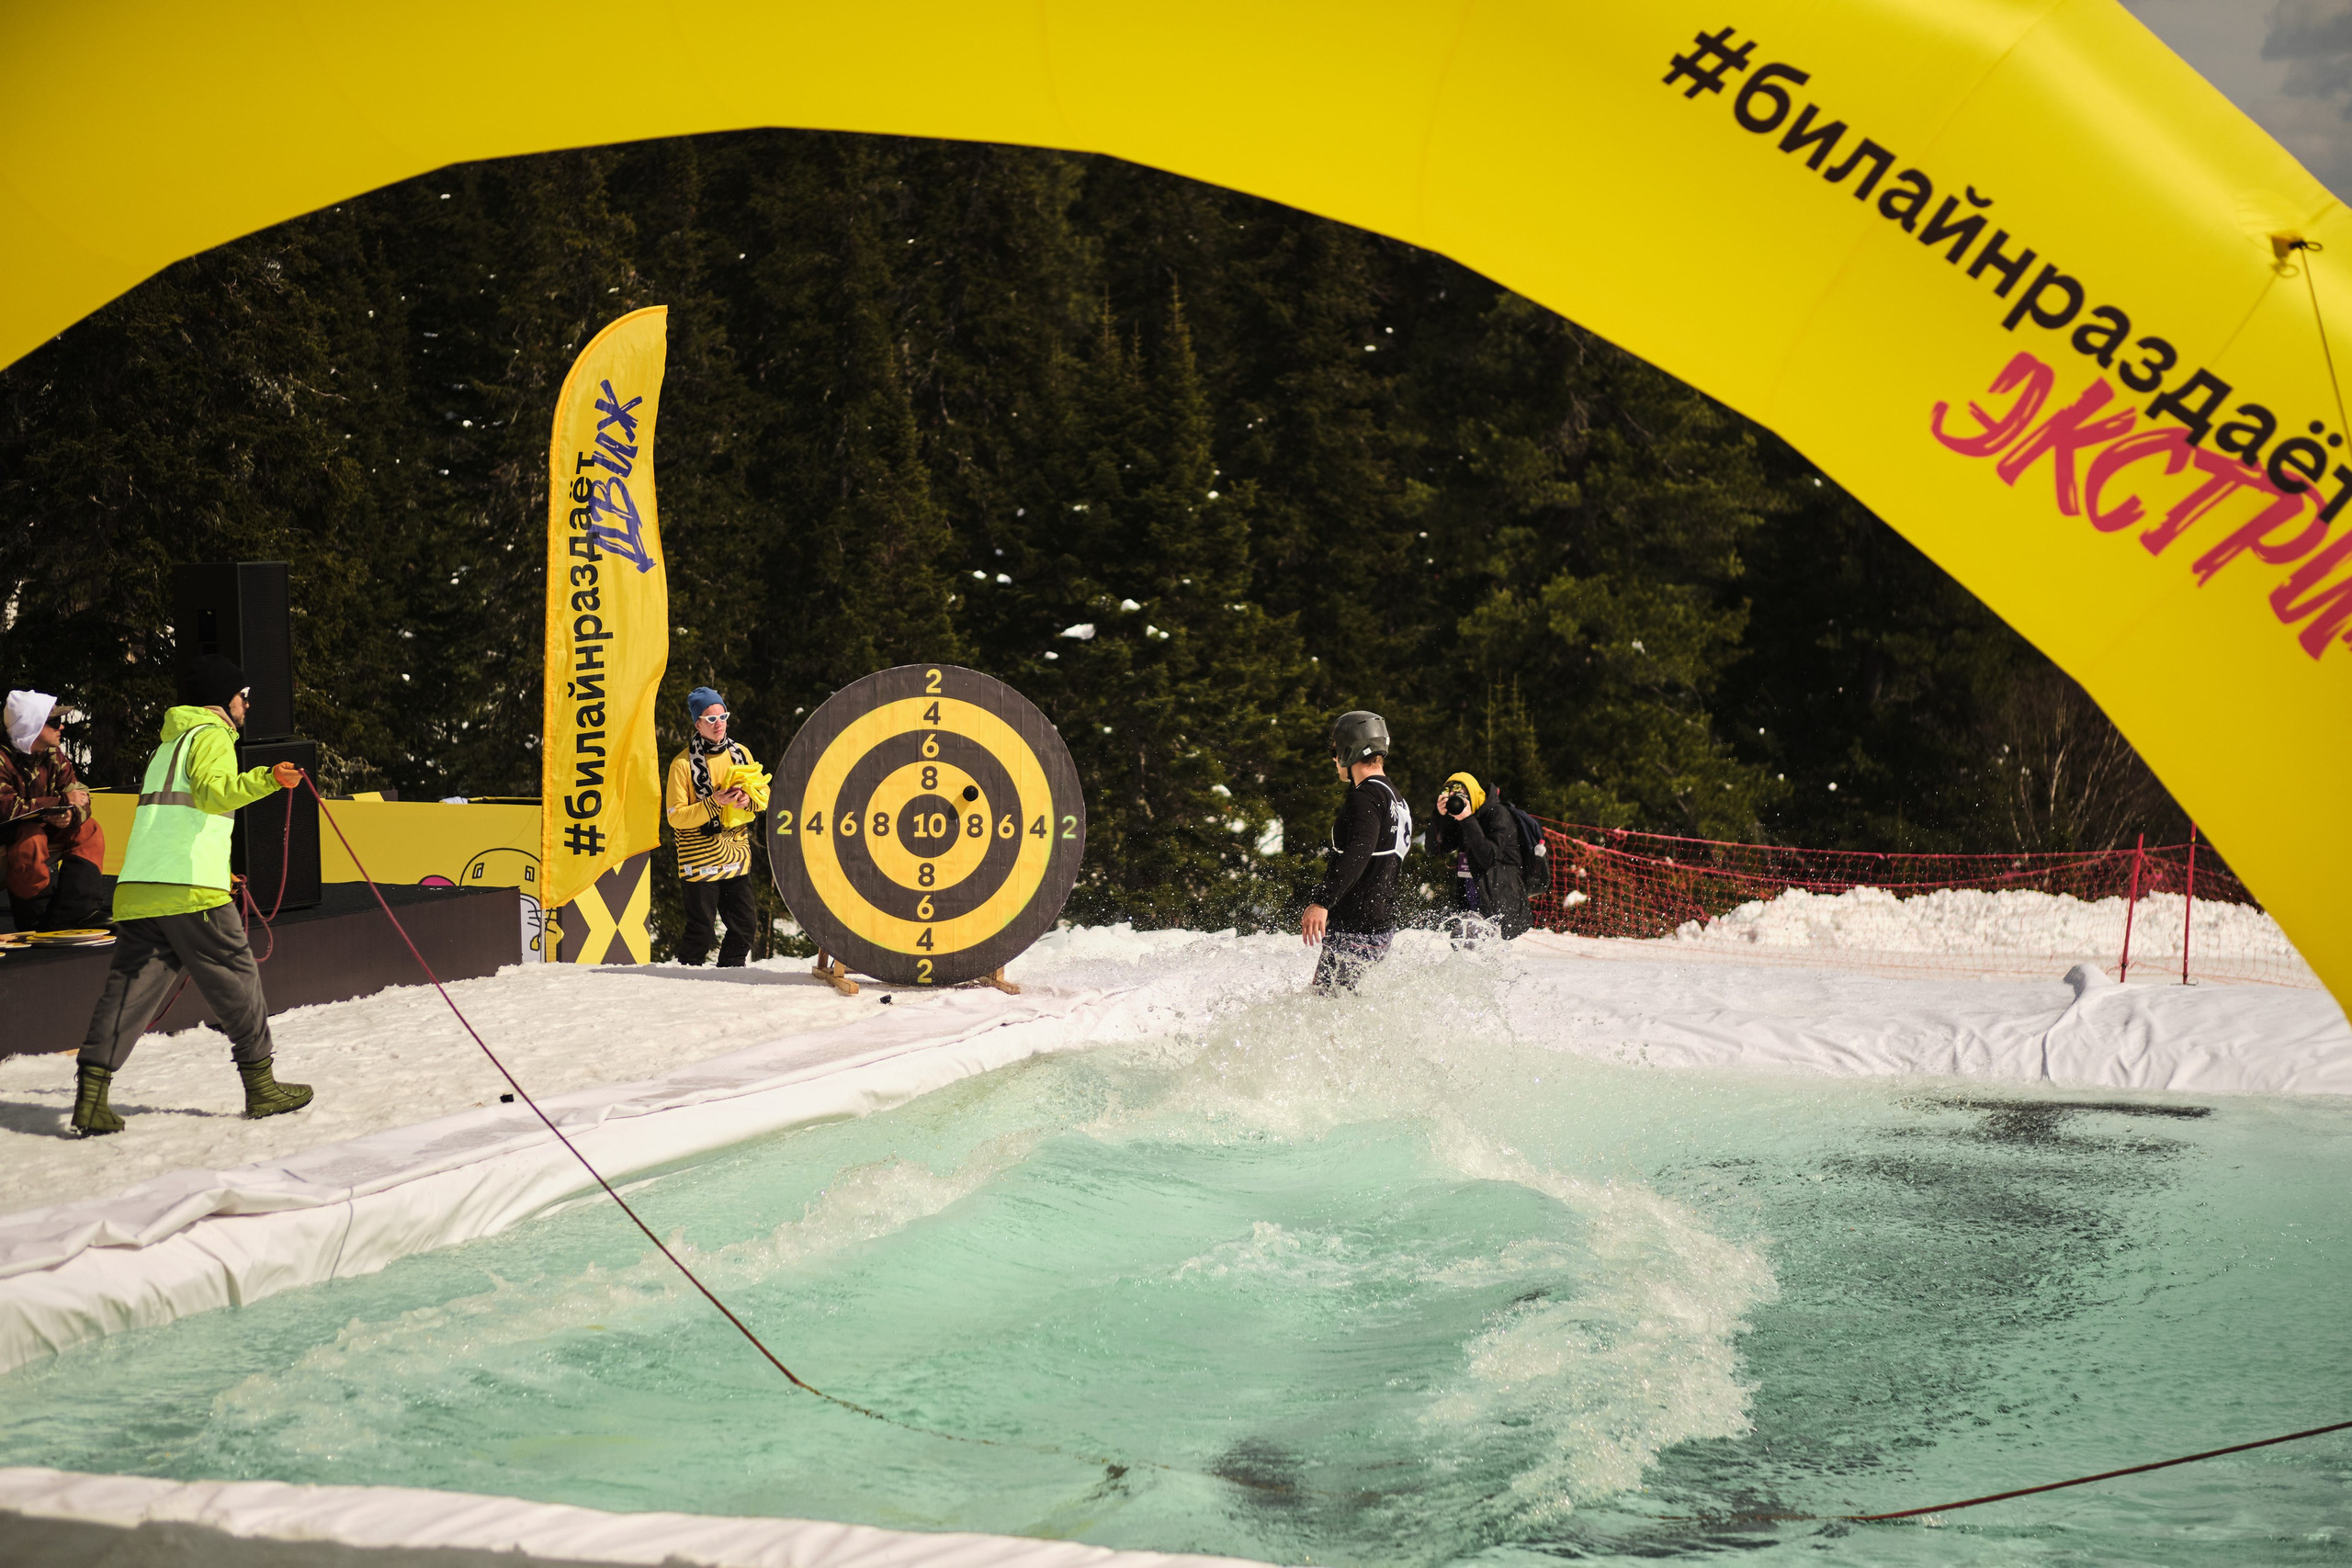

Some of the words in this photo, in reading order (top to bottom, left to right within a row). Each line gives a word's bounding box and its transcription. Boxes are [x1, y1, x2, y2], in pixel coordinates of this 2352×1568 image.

[564, 451, 614, 857] #билайнраздаёт
[925, 669, 943, 694] 2
[923, 701, 942, 726] 4
[922, 733, 940, 759] 6
[921, 765, 939, 791] 8
[776, 810, 794, 835] 2
[806, 811, 824, 836] 4
[840, 812, 858, 837] 6
[872, 812, 890, 837] 8
[912, 812, 947, 839] 10
[967, 814, 984, 839] 8
[997, 814, 1015, 840] 6
[1029, 815, 1047, 840] 4
[1061, 815, 1078, 840] 2
[918, 862, 935, 887] 8
[916, 895, 935, 920] 6
[916, 927, 934, 952] 4
[917, 958, 933, 984] 2
